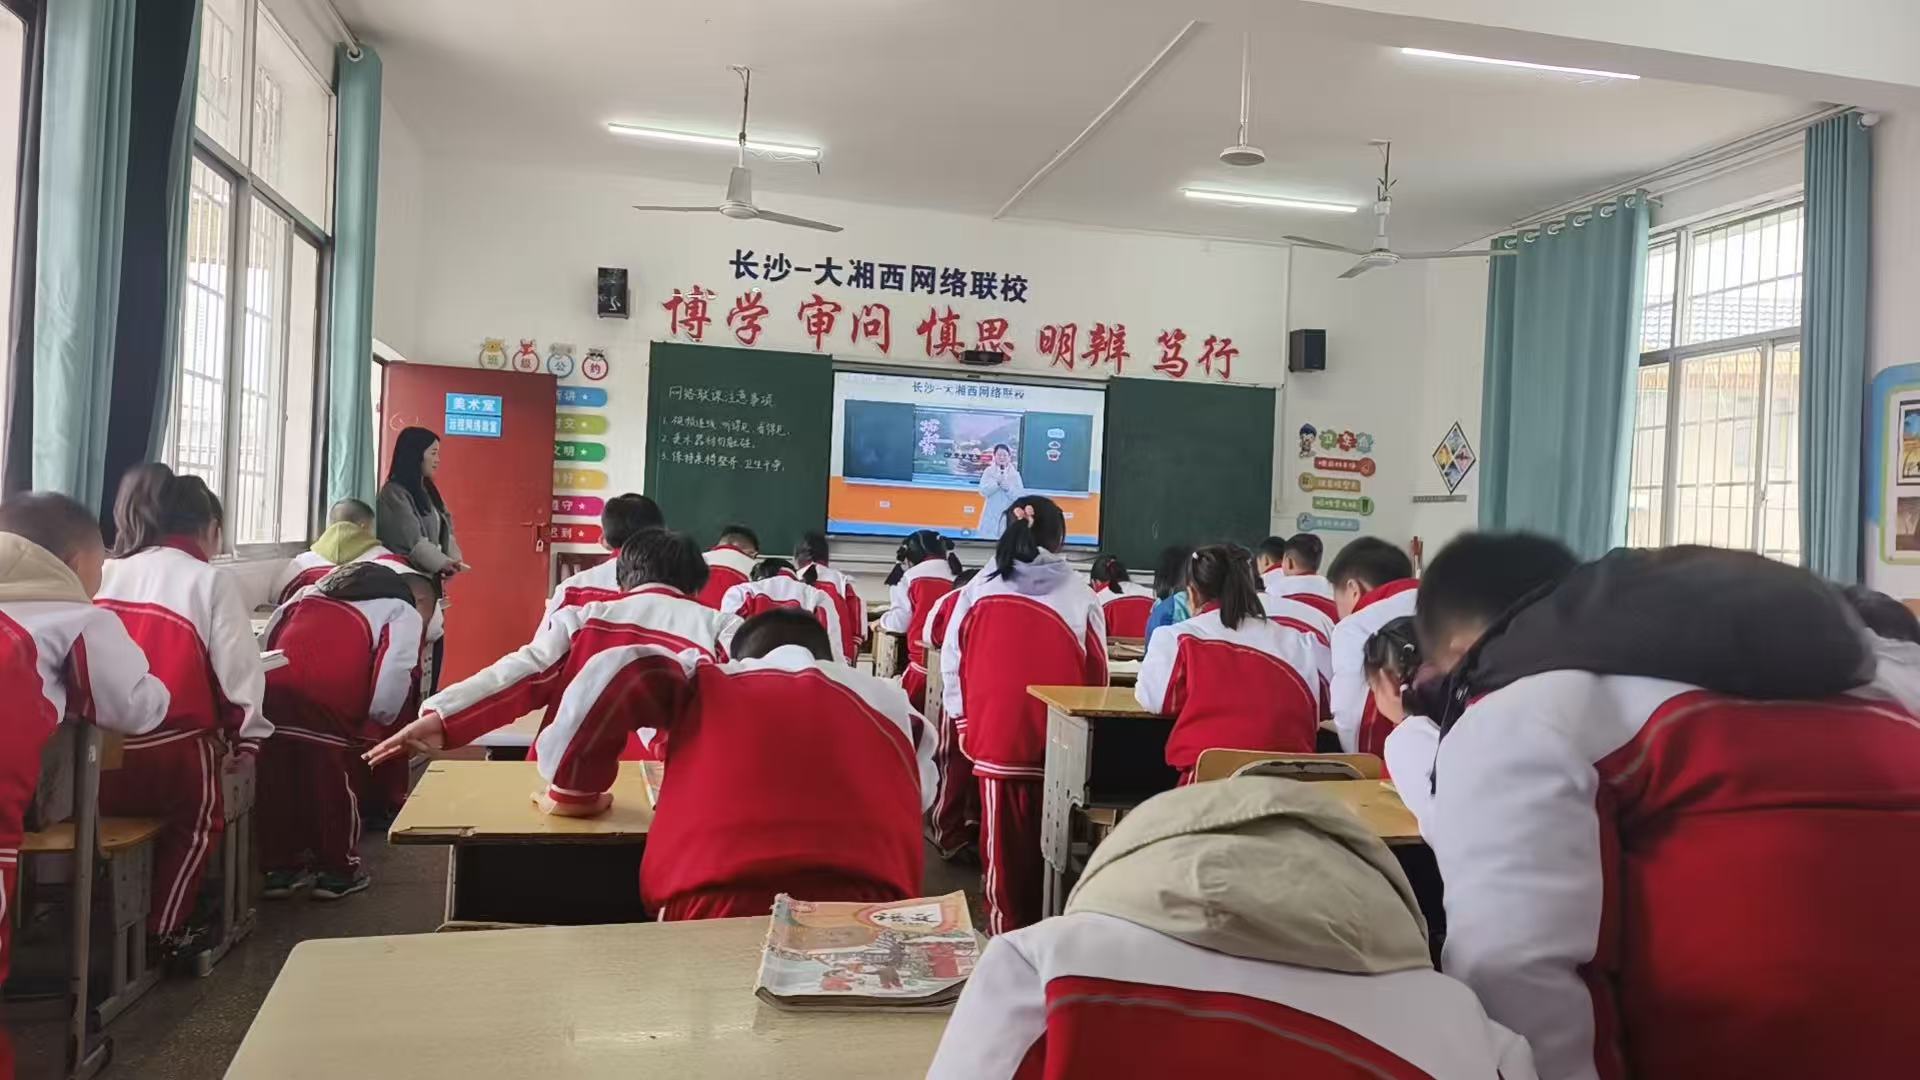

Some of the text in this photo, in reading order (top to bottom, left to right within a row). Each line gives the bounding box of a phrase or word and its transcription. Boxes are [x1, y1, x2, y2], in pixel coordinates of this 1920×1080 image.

[729, 248, 1029, 303] 长沙-大湘西网络联校
[662, 287, 1240, 380] 博学 审问 慎思 明辨 笃行
[453, 397, 497, 412] 美术室
